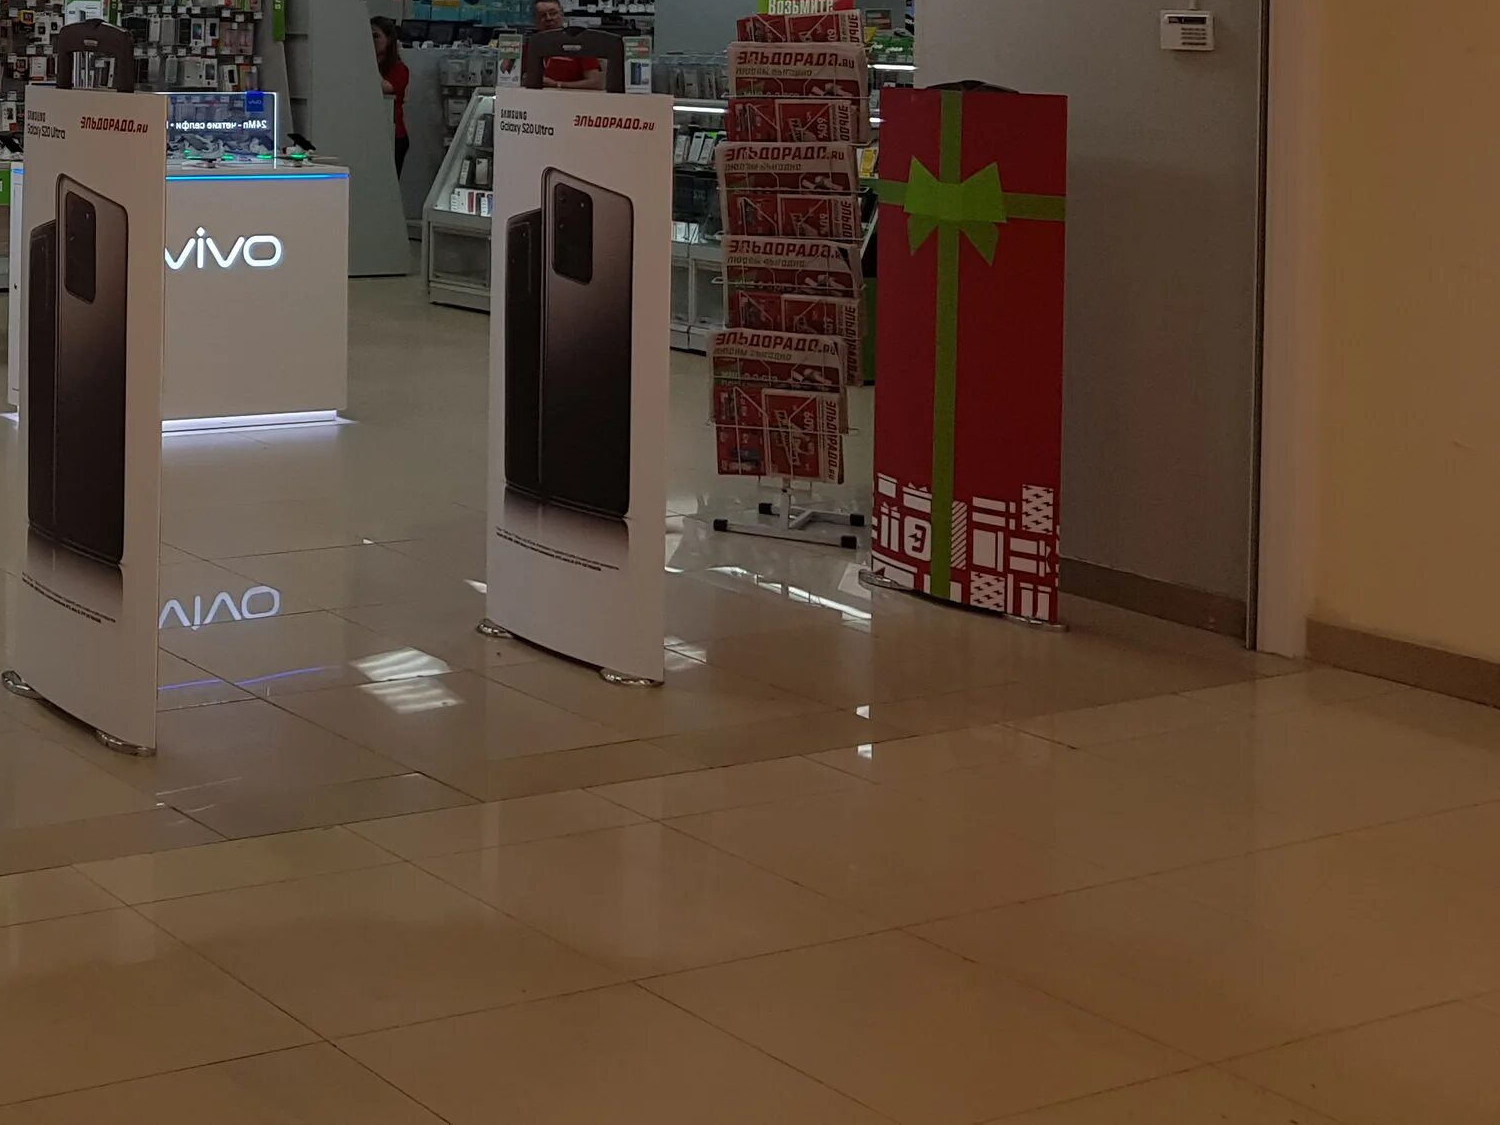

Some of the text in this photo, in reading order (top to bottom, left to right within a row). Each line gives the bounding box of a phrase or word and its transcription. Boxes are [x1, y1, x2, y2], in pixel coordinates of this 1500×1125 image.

[500, 108, 528, 121] SAMSUNG
[572, 114, 655, 131] ЭЛЬДОРАДО.RU
[80, 116, 149, 134] ЭЛЬДОРАДО.RU
[499, 120, 554, 136] Galaxy S20 Ultra
